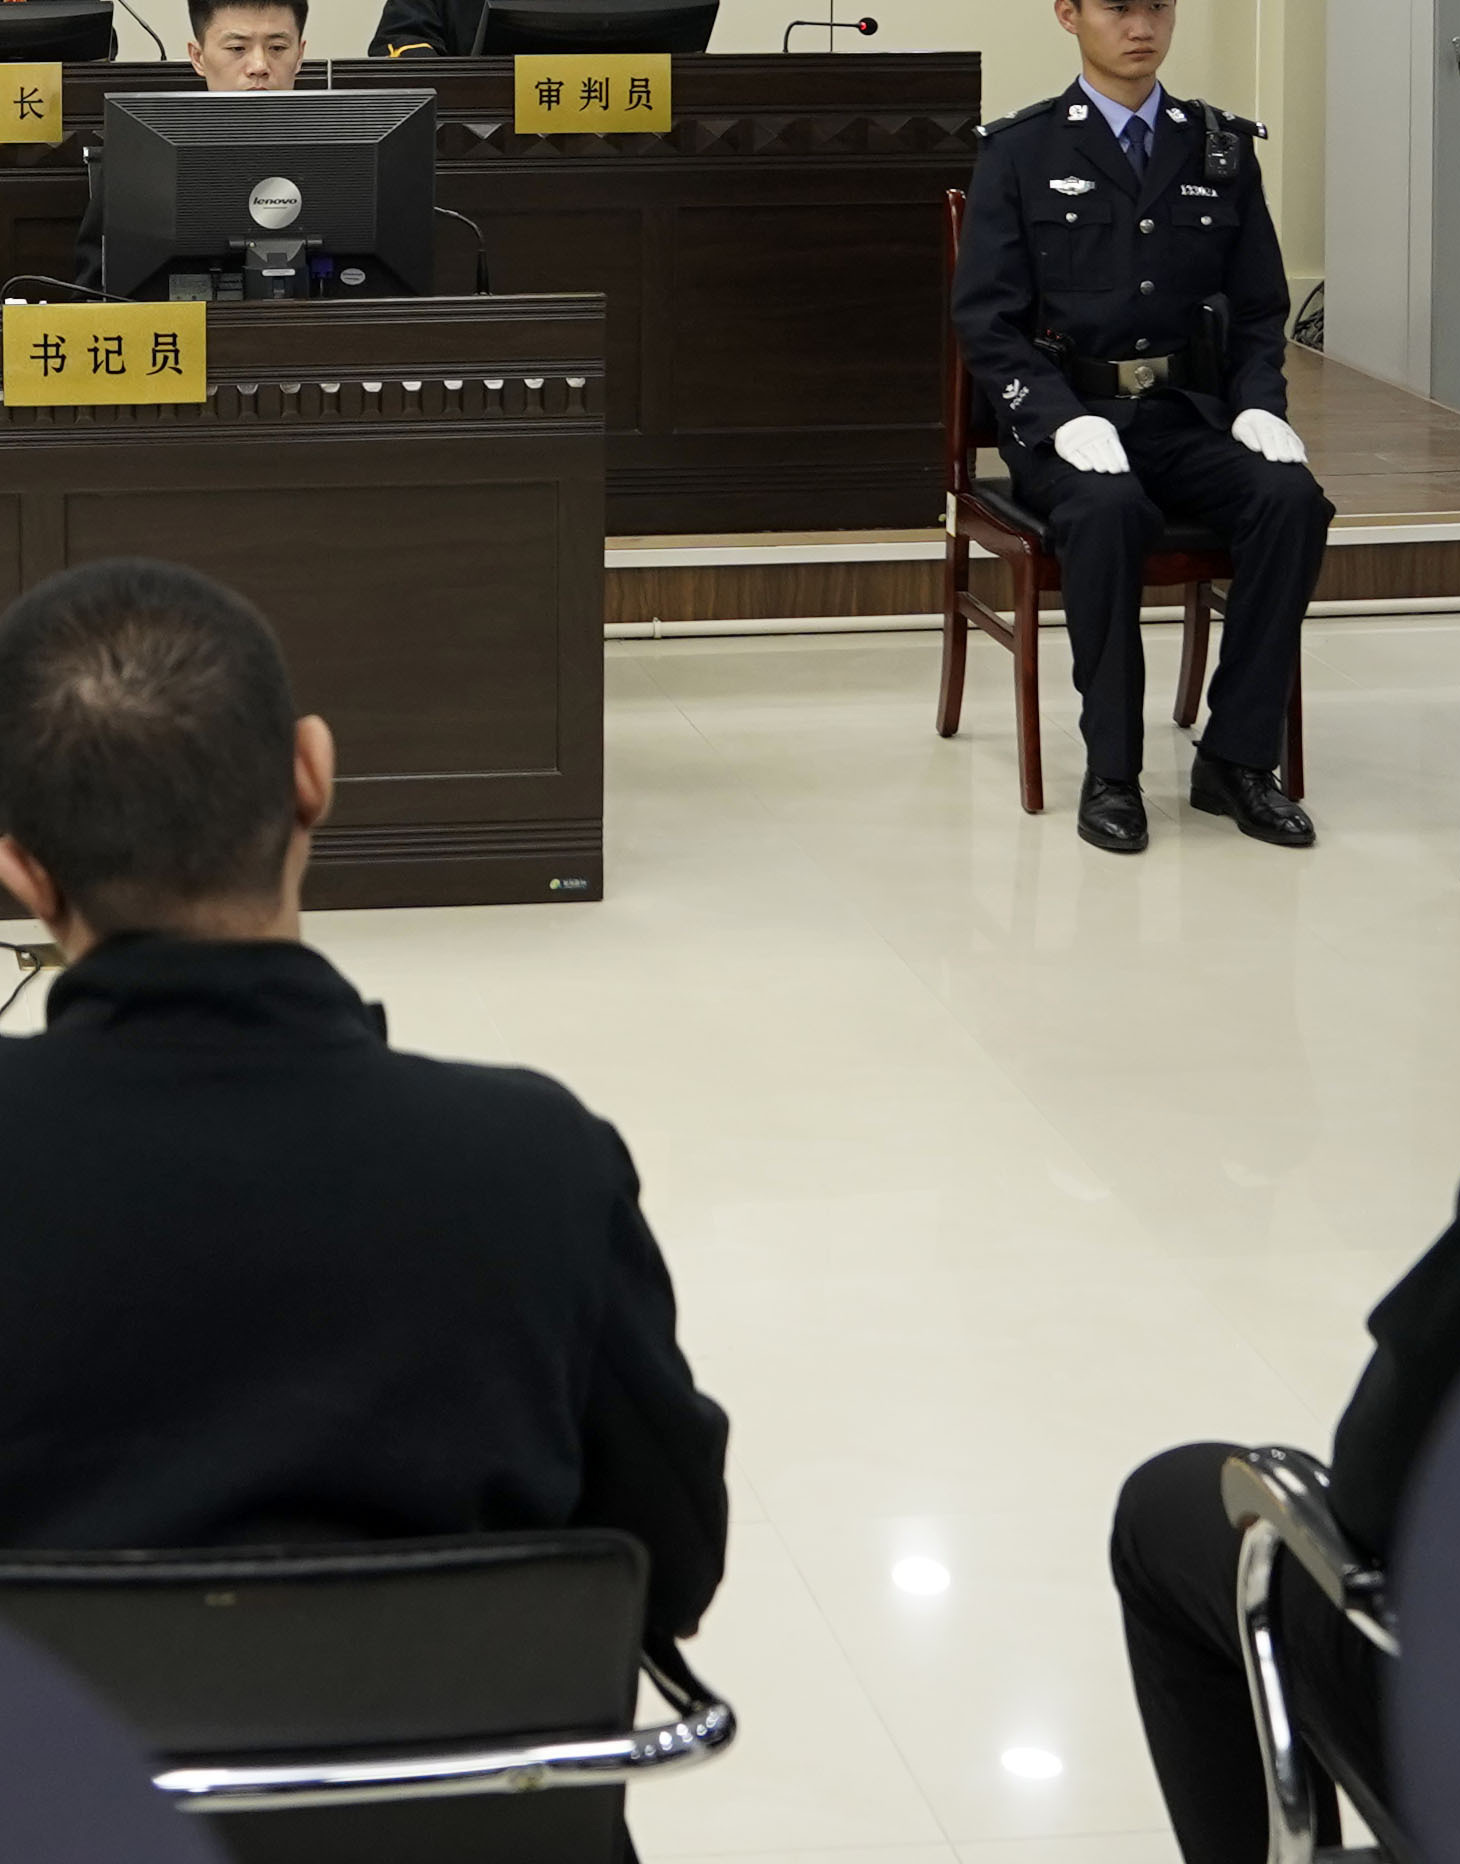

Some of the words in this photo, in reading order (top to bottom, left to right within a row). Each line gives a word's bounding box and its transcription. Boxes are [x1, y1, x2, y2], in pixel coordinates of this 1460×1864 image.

[534, 77, 654, 112] 审判员
[253, 196, 298, 206] lenovo
[29, 331, 183, 377] 书记员
